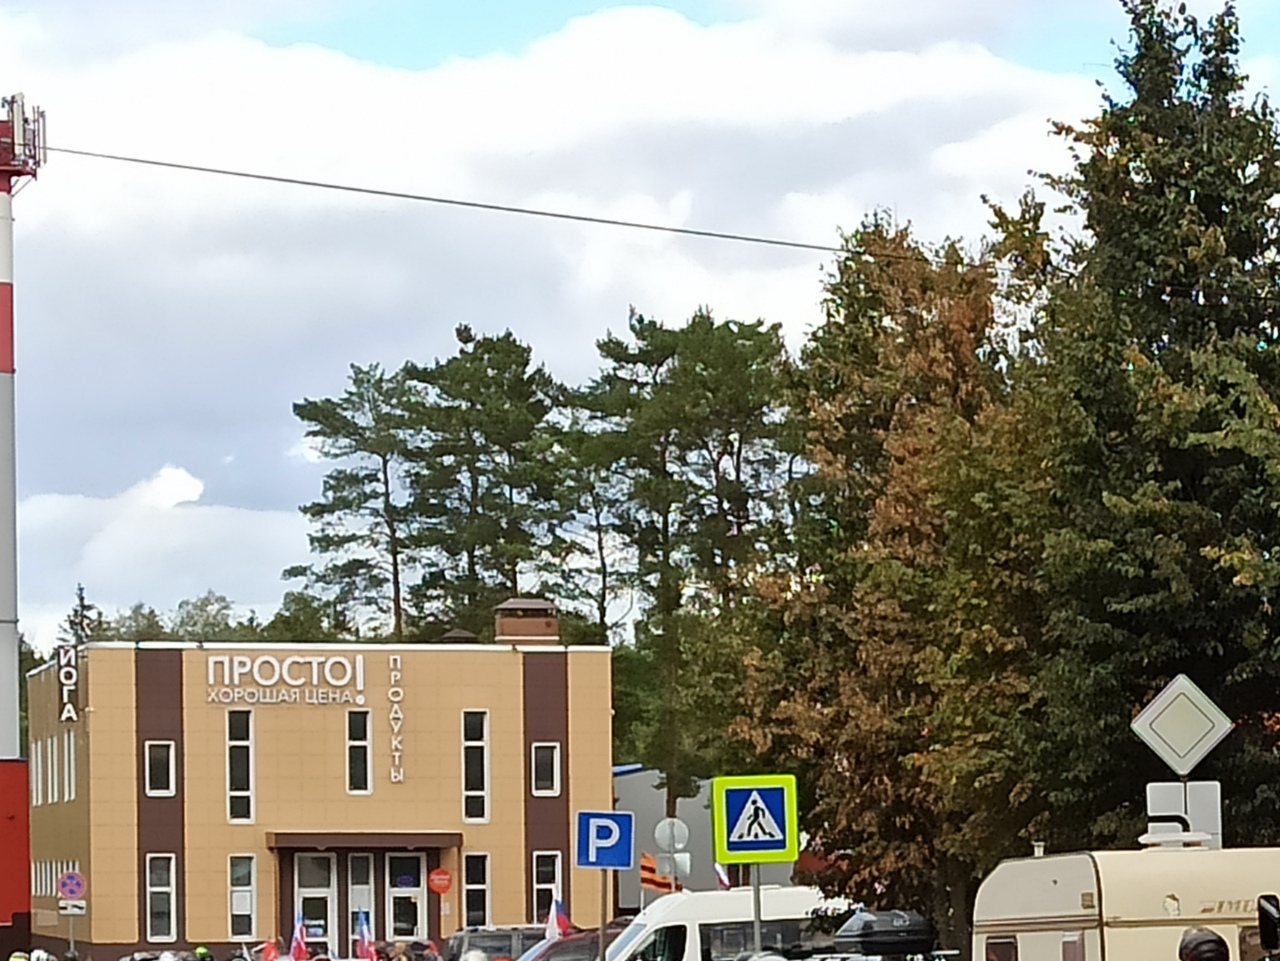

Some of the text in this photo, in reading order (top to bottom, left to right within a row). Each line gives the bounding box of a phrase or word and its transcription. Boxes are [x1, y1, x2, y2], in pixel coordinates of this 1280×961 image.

[208, 688, 353, 704] ХОРОШАЯ ЦЕНА
[388, 655, 404, 782] ПРОДУКТЫ
[588, 818, 620, 862] P
